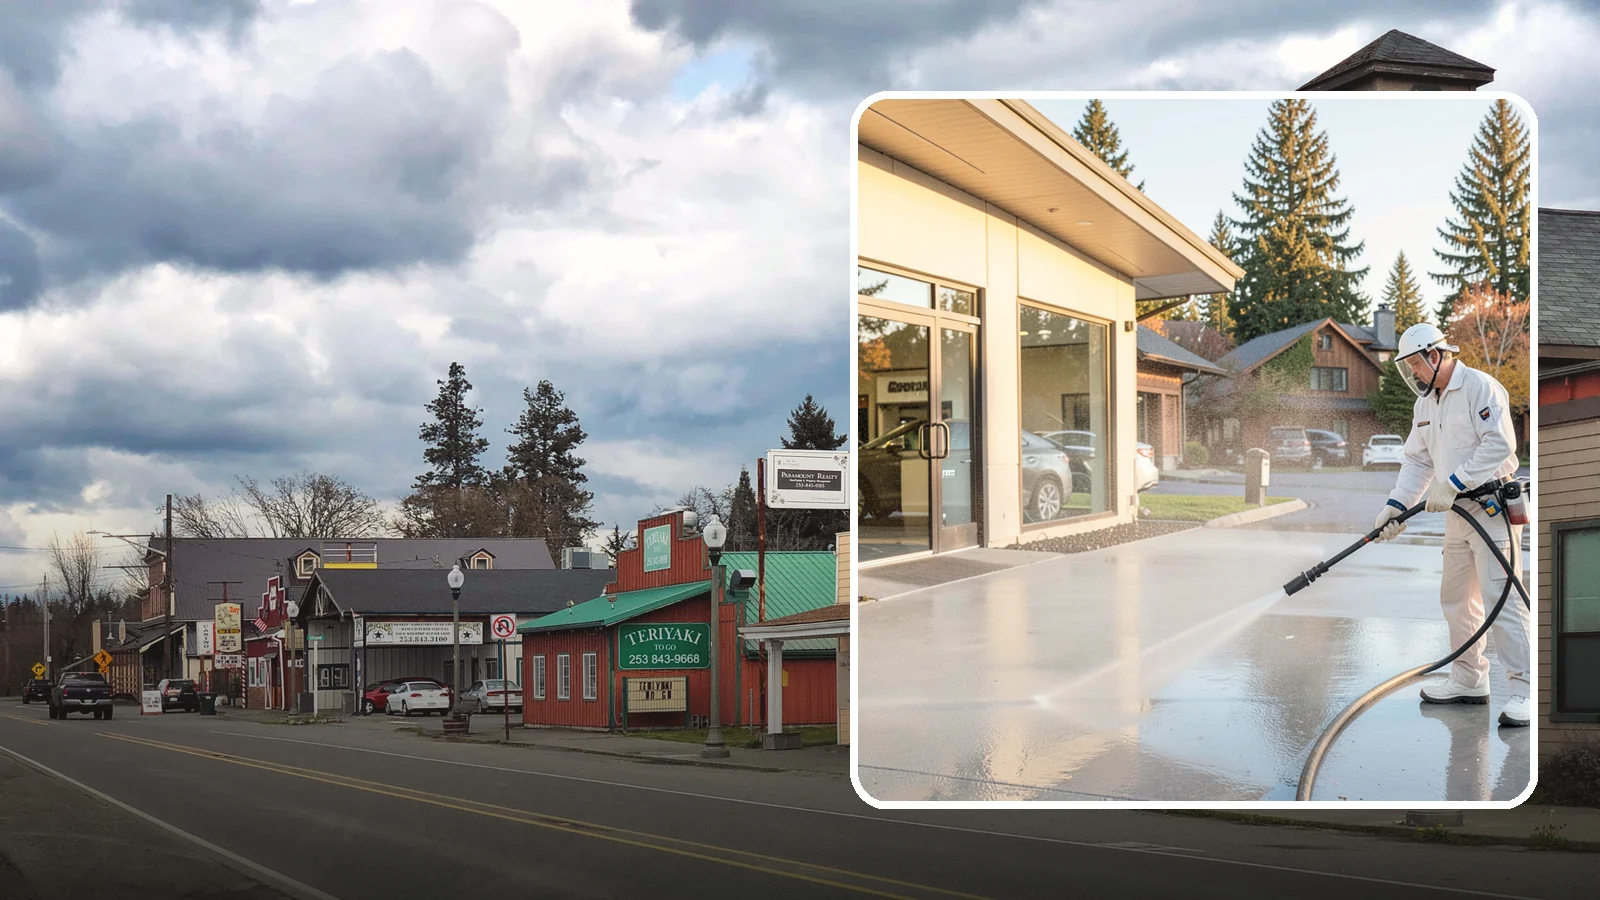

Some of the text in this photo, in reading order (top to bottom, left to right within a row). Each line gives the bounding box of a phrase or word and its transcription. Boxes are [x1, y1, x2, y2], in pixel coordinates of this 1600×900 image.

[624, 627, 702, 646] TERIYAKI
[629, 654, 700, 664] 253 843-9668
[639, 681, 673, 691] TERIYAKI
